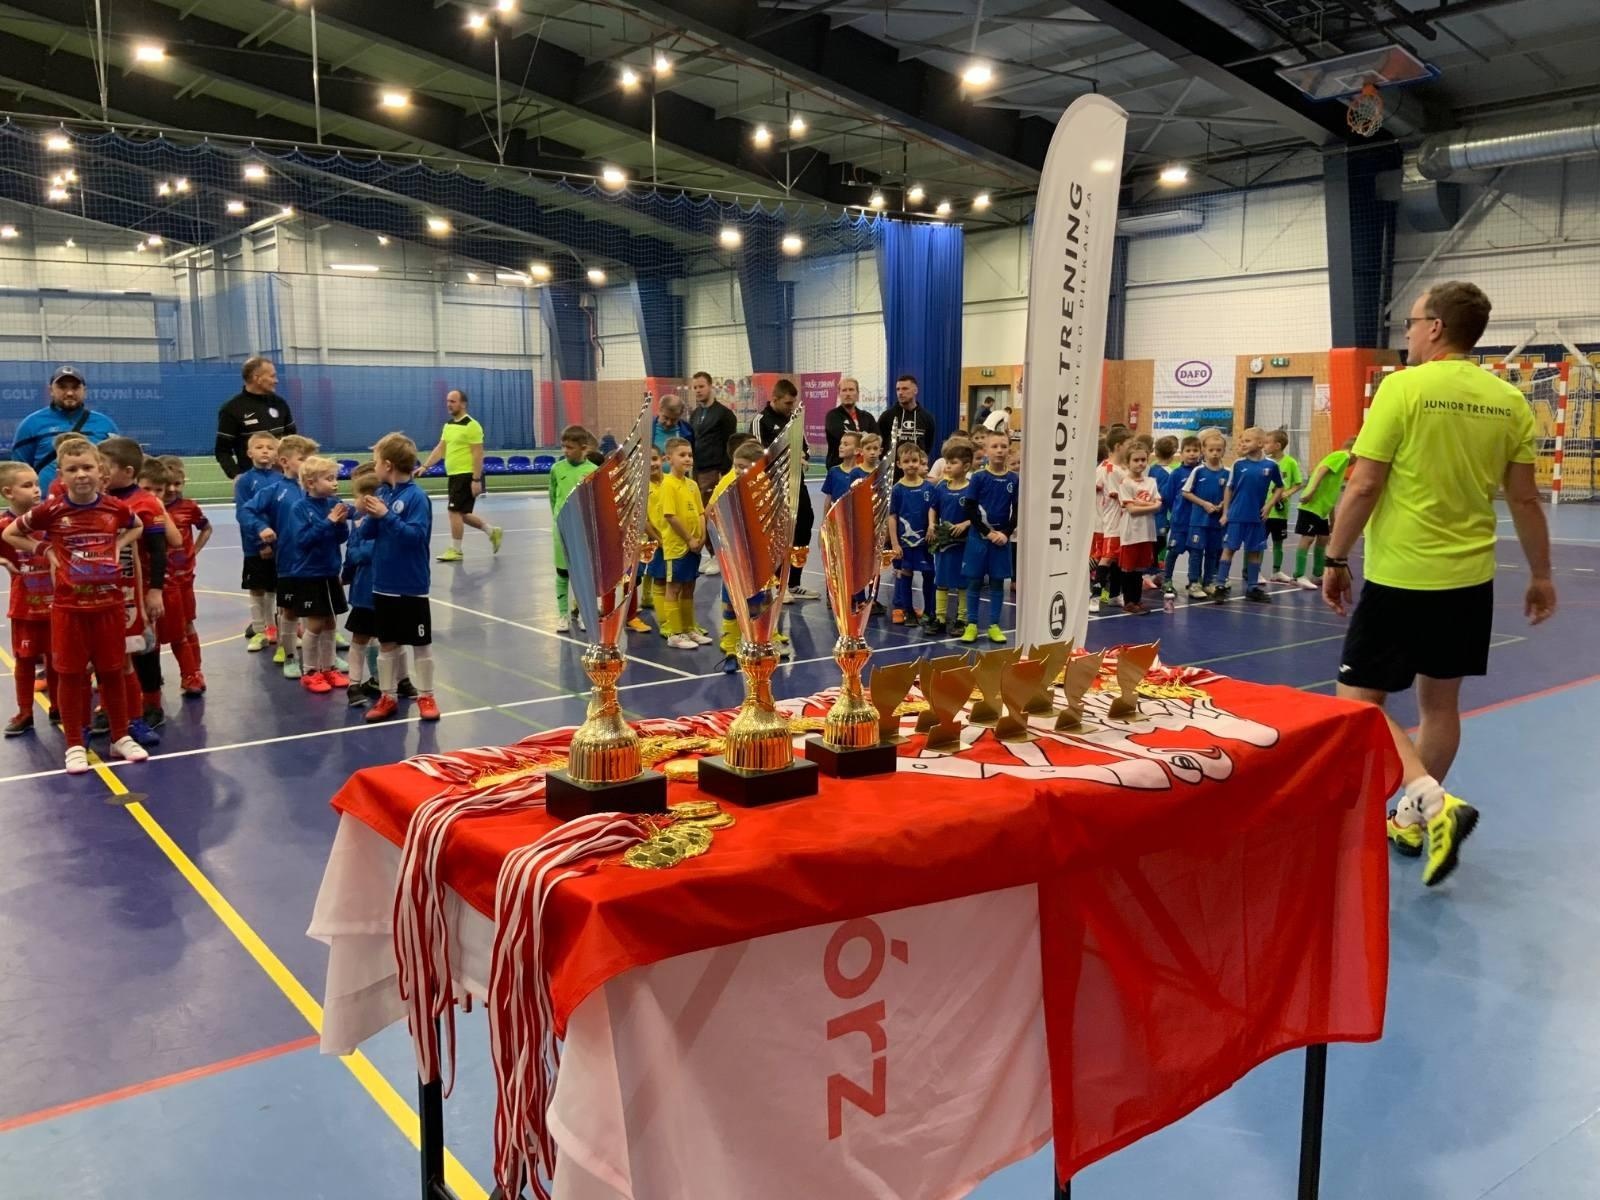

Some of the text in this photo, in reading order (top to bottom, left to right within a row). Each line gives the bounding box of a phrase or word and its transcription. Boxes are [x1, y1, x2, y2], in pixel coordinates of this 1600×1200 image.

[1049, 181, 1082, 552] JUNIOR TRENING
[1180, 369, 1208, 379] DAFO
[2, 388, 39, 400] GOLF
[1424, 400, 1464, 411] JUNIOR
[1466, 403, 1511, 417] TRENING
[417, 623, 425, 637] 6
